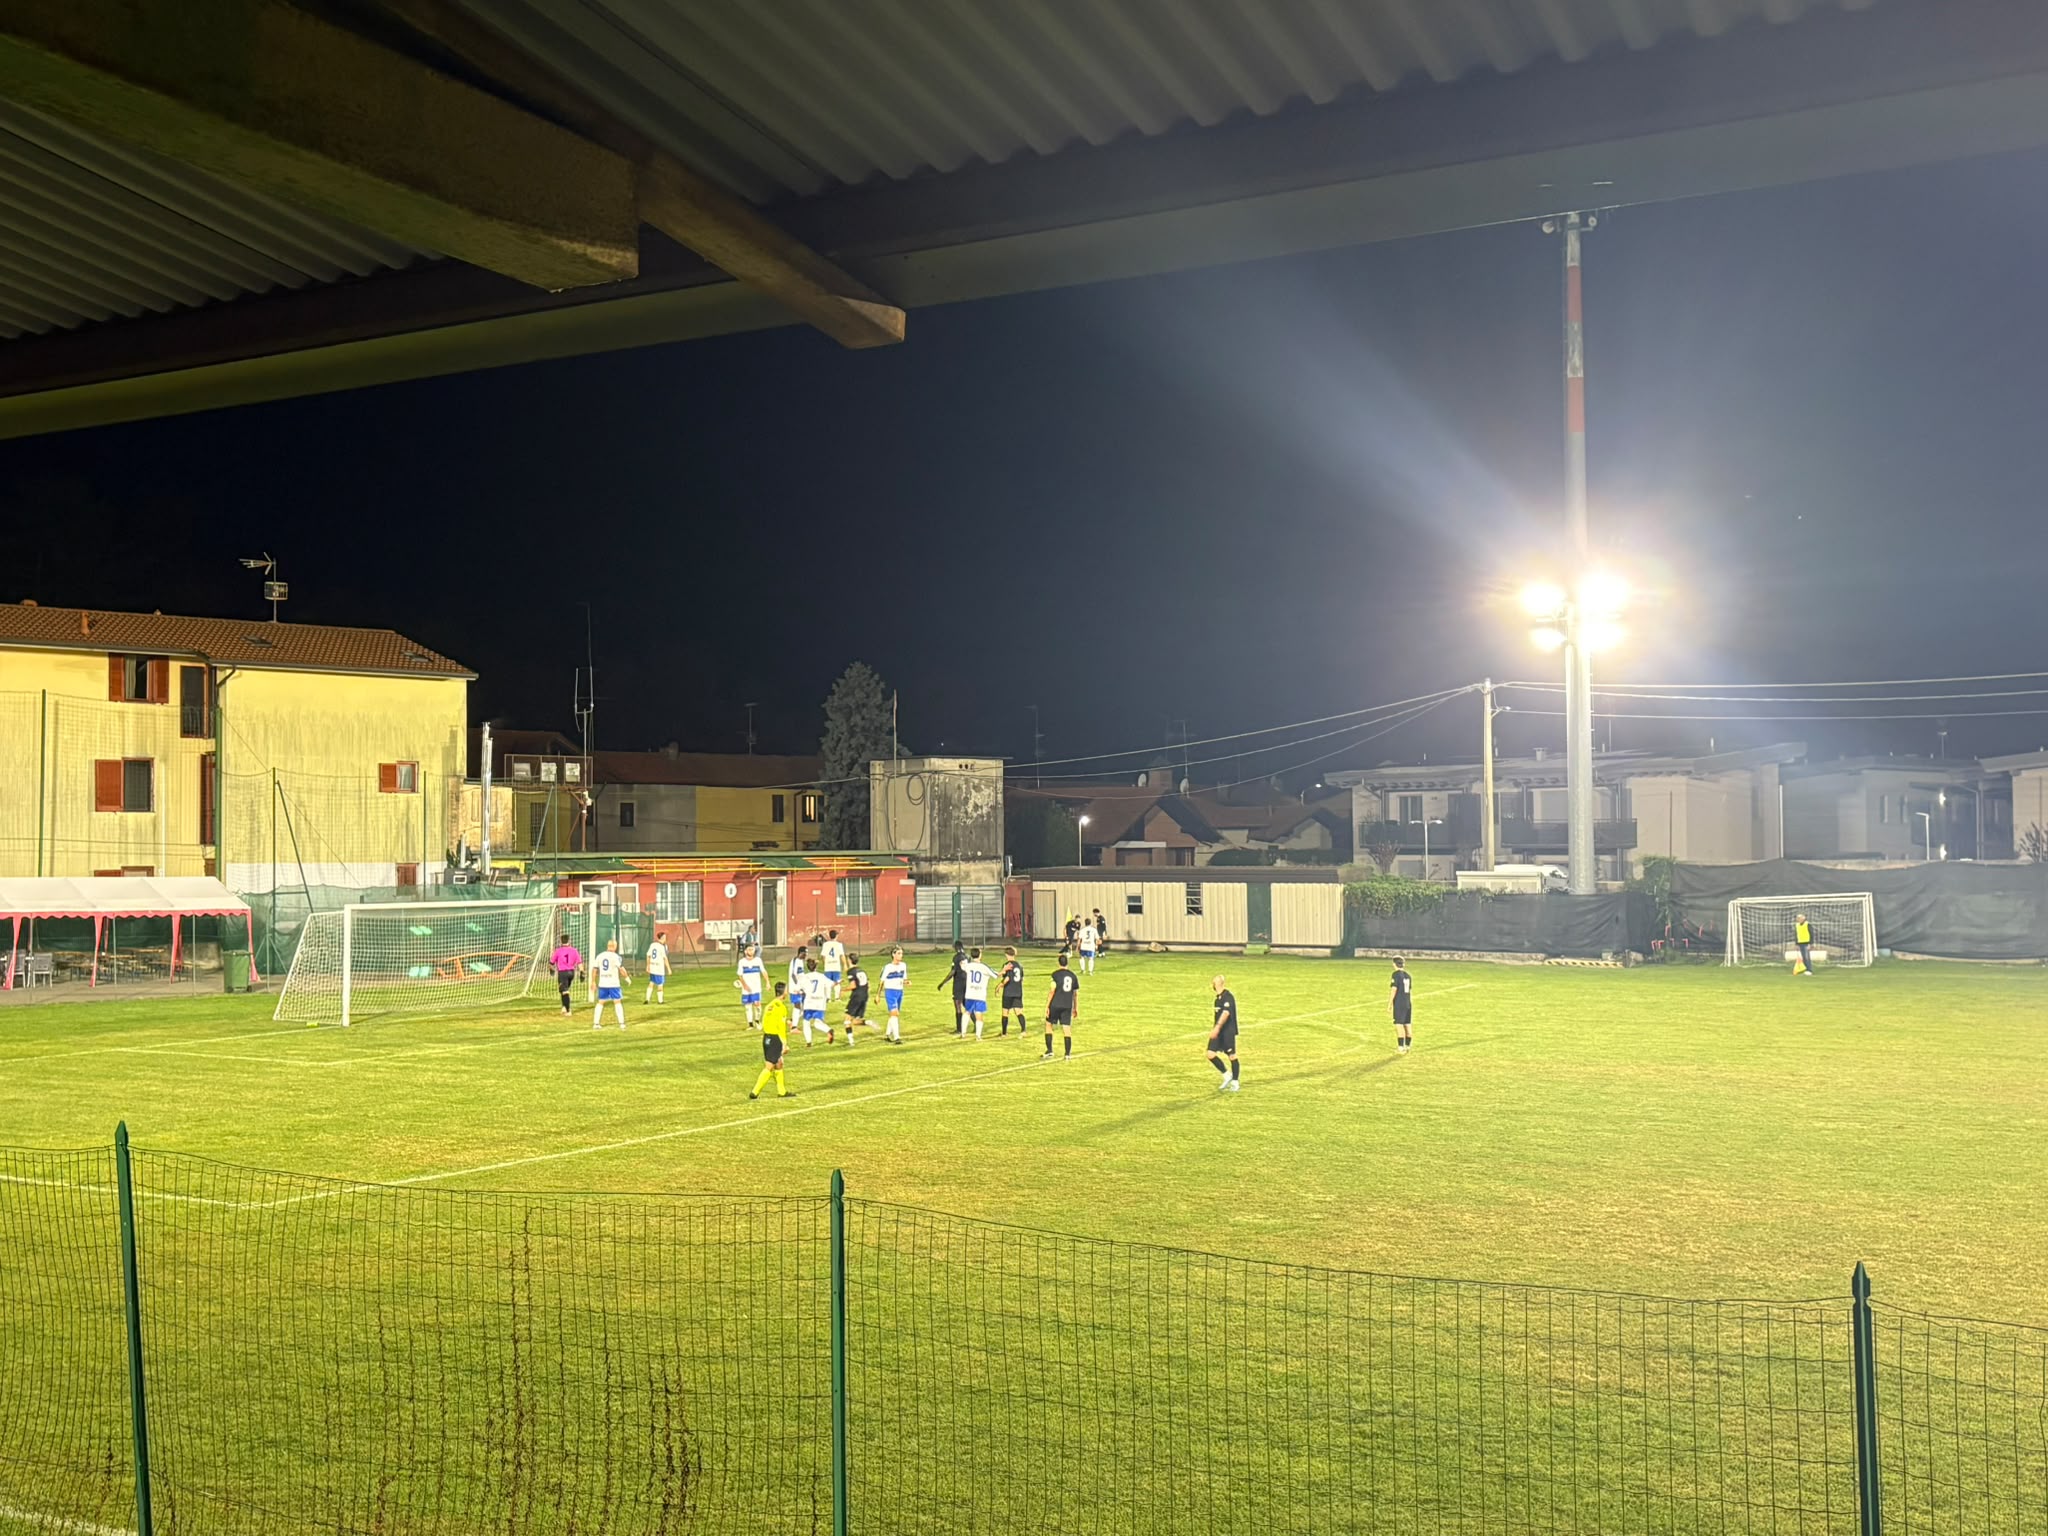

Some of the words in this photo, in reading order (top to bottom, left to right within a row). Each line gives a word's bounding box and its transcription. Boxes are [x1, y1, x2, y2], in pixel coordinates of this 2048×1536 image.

[564, 954, 569, 963] 1
[652, 949, 657, 959] 8
[829, 947, 835, 958] 4
[603, 959, 609, 971] 9
[970, 970, 982, 984] 10
[1013, 968, 1020, 982] 3
[811, 980, 818, 993] 7
[1063, 976, 1072, 992] 8
